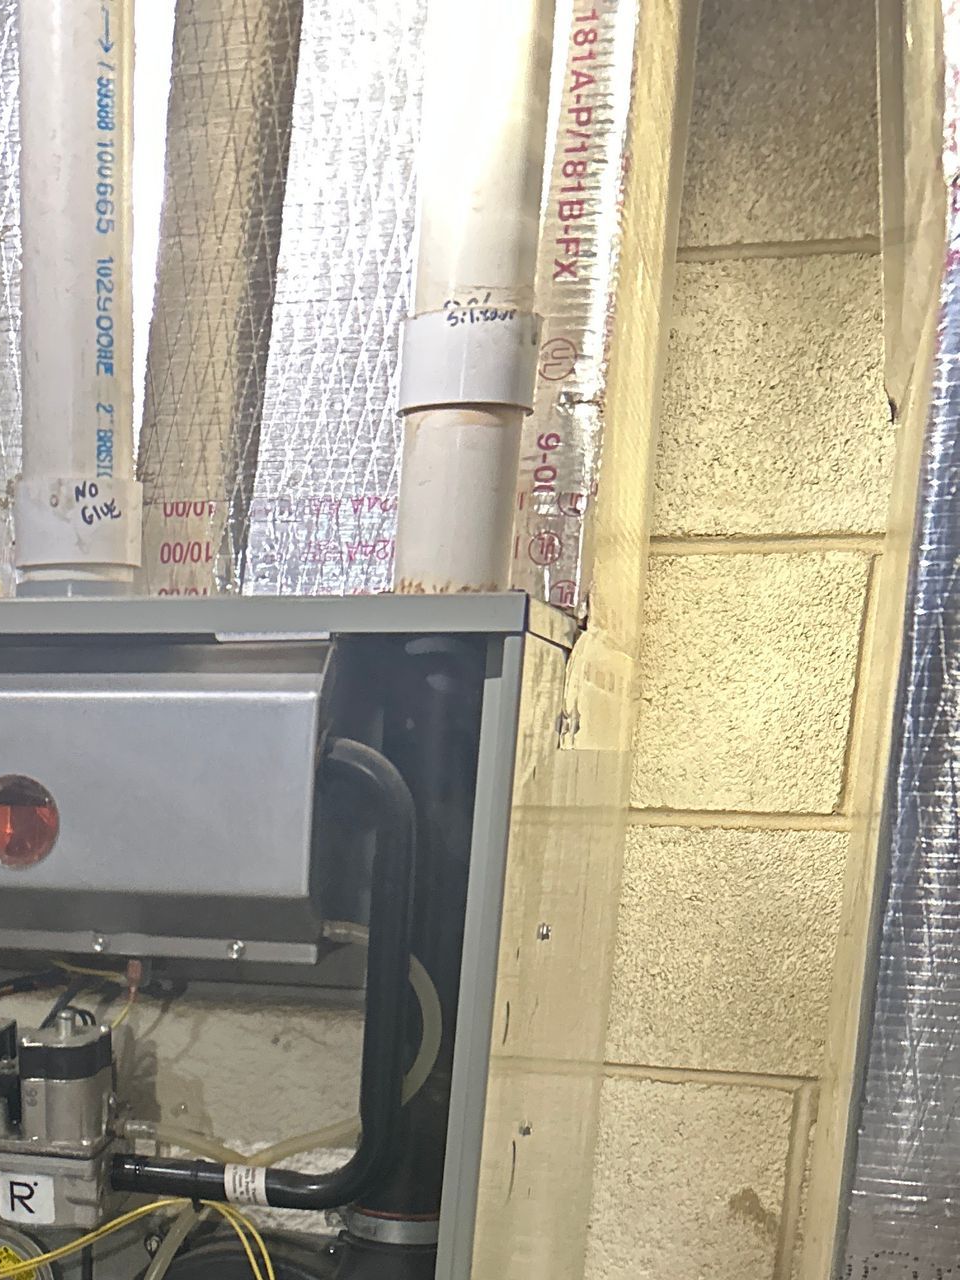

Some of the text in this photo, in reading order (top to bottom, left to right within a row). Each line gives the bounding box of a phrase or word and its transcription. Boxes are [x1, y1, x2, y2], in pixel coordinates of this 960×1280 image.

[552, 9, 599, 280] 181A-P/181B-FX
[74, 481, 99, 503] NO
[160, 542, 213, 564] 10/00
[8, 1180, 38, 1215] R
